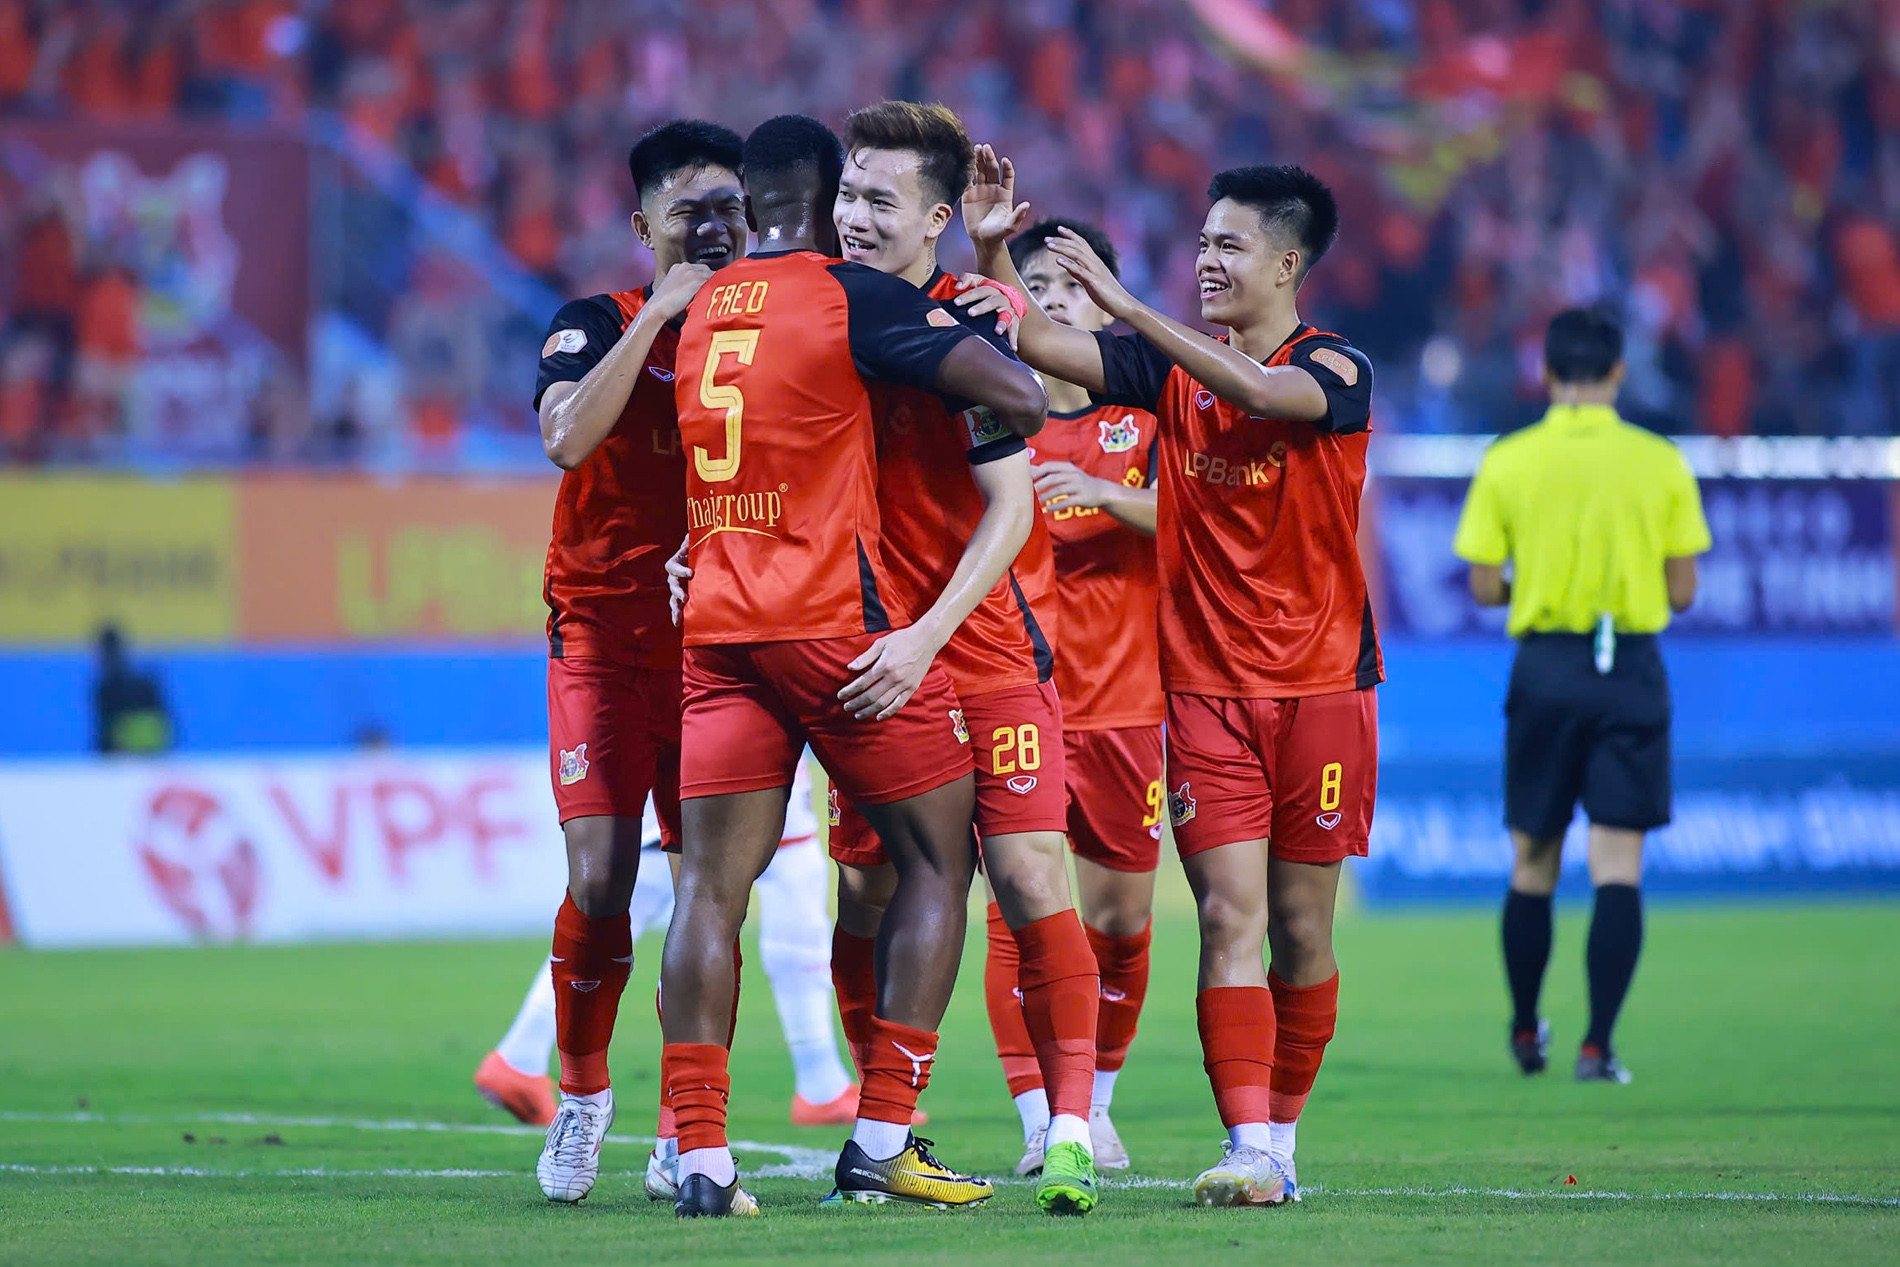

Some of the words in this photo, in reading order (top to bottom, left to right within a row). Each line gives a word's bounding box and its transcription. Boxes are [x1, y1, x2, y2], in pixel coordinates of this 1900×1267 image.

[706, 281, 769, 320] FRED
[693, 329, 761, 483] 5
[1184, 448, 1270, 486] LPBank
[992, 723, 1041, 776] 28
[1320, 762, 1343, 811] 8
[266, 776, 526, 886] VPF
[850, 1167, 889, 1185] MERCURIAL
